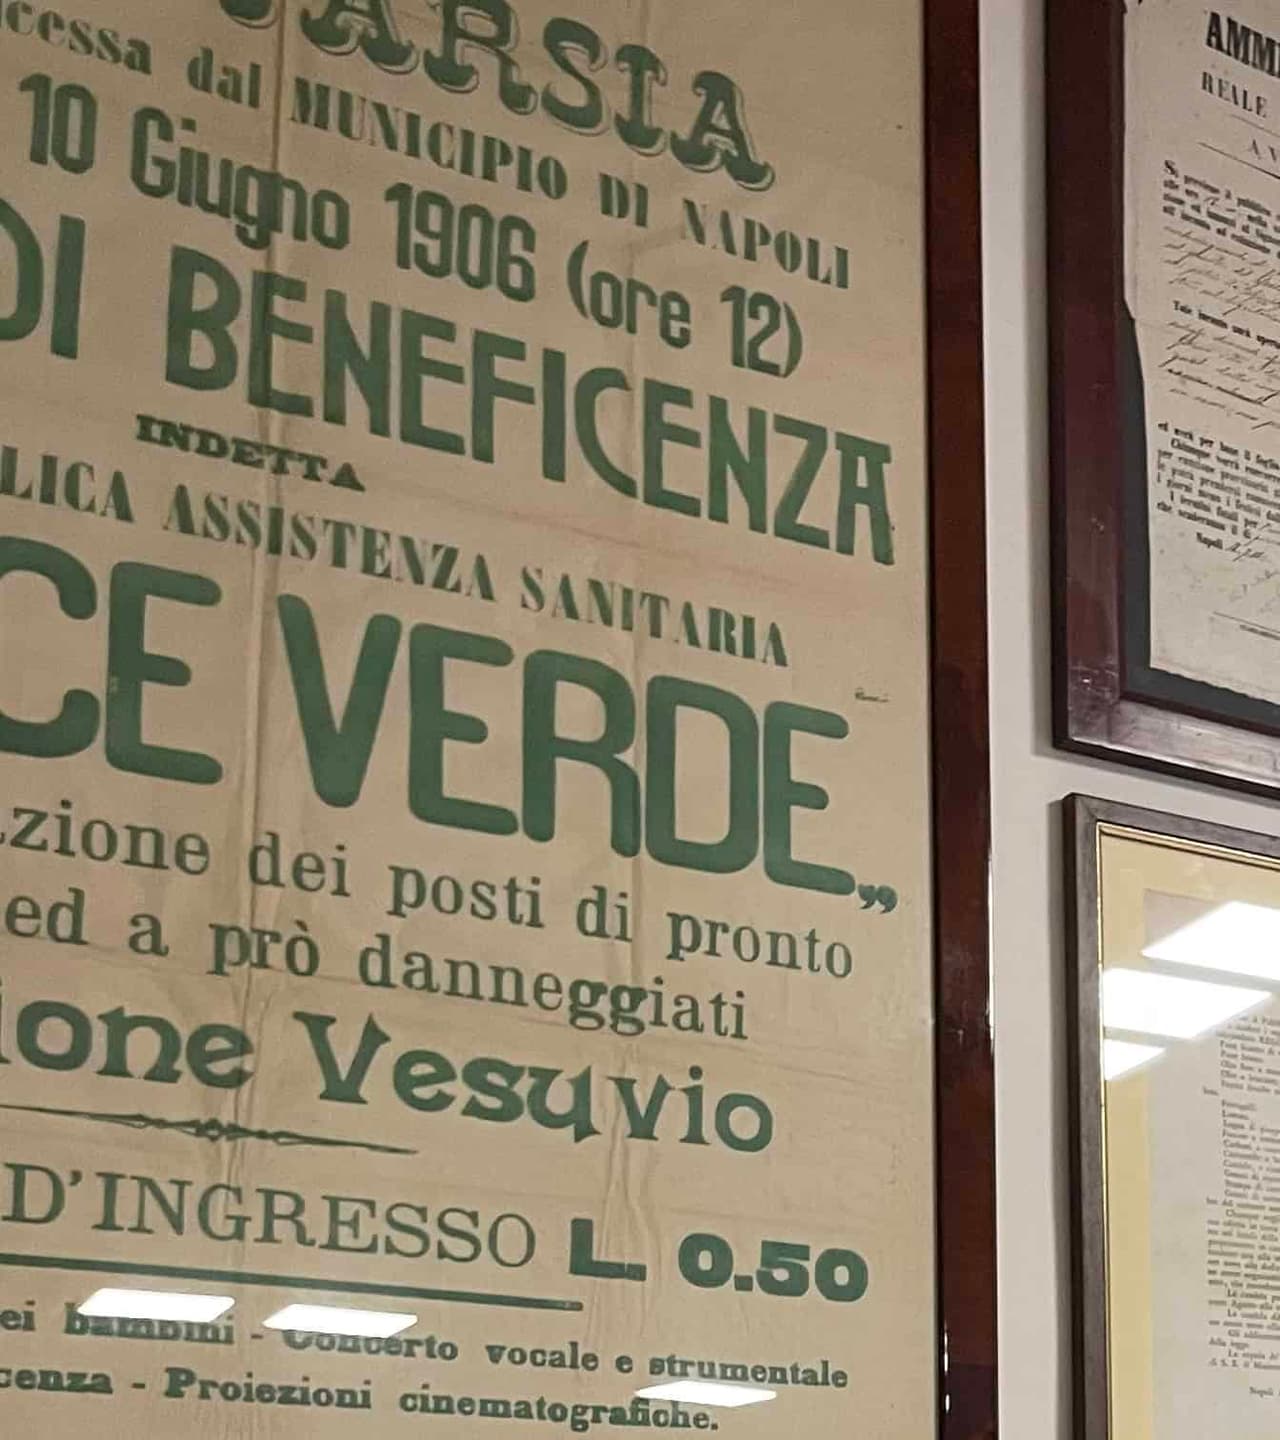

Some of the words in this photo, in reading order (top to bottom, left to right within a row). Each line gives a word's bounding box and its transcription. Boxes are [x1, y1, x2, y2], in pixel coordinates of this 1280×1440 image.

[187, 47, 261, 108] dal
[291, 76, 568, 199] MUNICIPIO
[600, 173, 648, 227] DI
[683, 198, 848, 289] NAPOLI
[219, 0, 775, 191] ARSIA
[1202, 72, 1268, 119] REALE
[19, 73, 97, 174] 10
[130, 107, 350, 249] Giugno
[384, 182, 536, 302] 1906
[567, 240, 690, 349] (ore
[720, 285, 803, 378] 12)
[136, 414, 366, 492] INDETTA
[164, 244, 895, 566] BENEFICENZA
[163, 484, 497, 602] ASSISTENZA
[520, 566, 789, 668] SANITARIA
[0, 799, 211, 876] zione
[249, 831, 350, 897] dei
[388, 863, 544, 930] posti
[576, 885, 633, 944] di
[666, 908, 854, 979] pronto
[5, 887, 90, 945] ed
[129, 914, 169, 957] a
[207, 920, 320, 977] prò
[358, 934, 750, 1042] danneggiati
[0, 975, 254, 1089] one
[292, 1010, 774, 1154] Vesuvio
[2, 1162, 536, 1267] D'INGRESSO
[678, 1233, 868, 1302] 0.50
[165, 1367, 371, 1409] Proiezioni
[399, 1382, 719, 1432] cinematografiche.
[485, 1342, 598, 1371] vocale
[616, 1354, 633, 1373] e
[649, 1353, 848, 1388] strumentale
